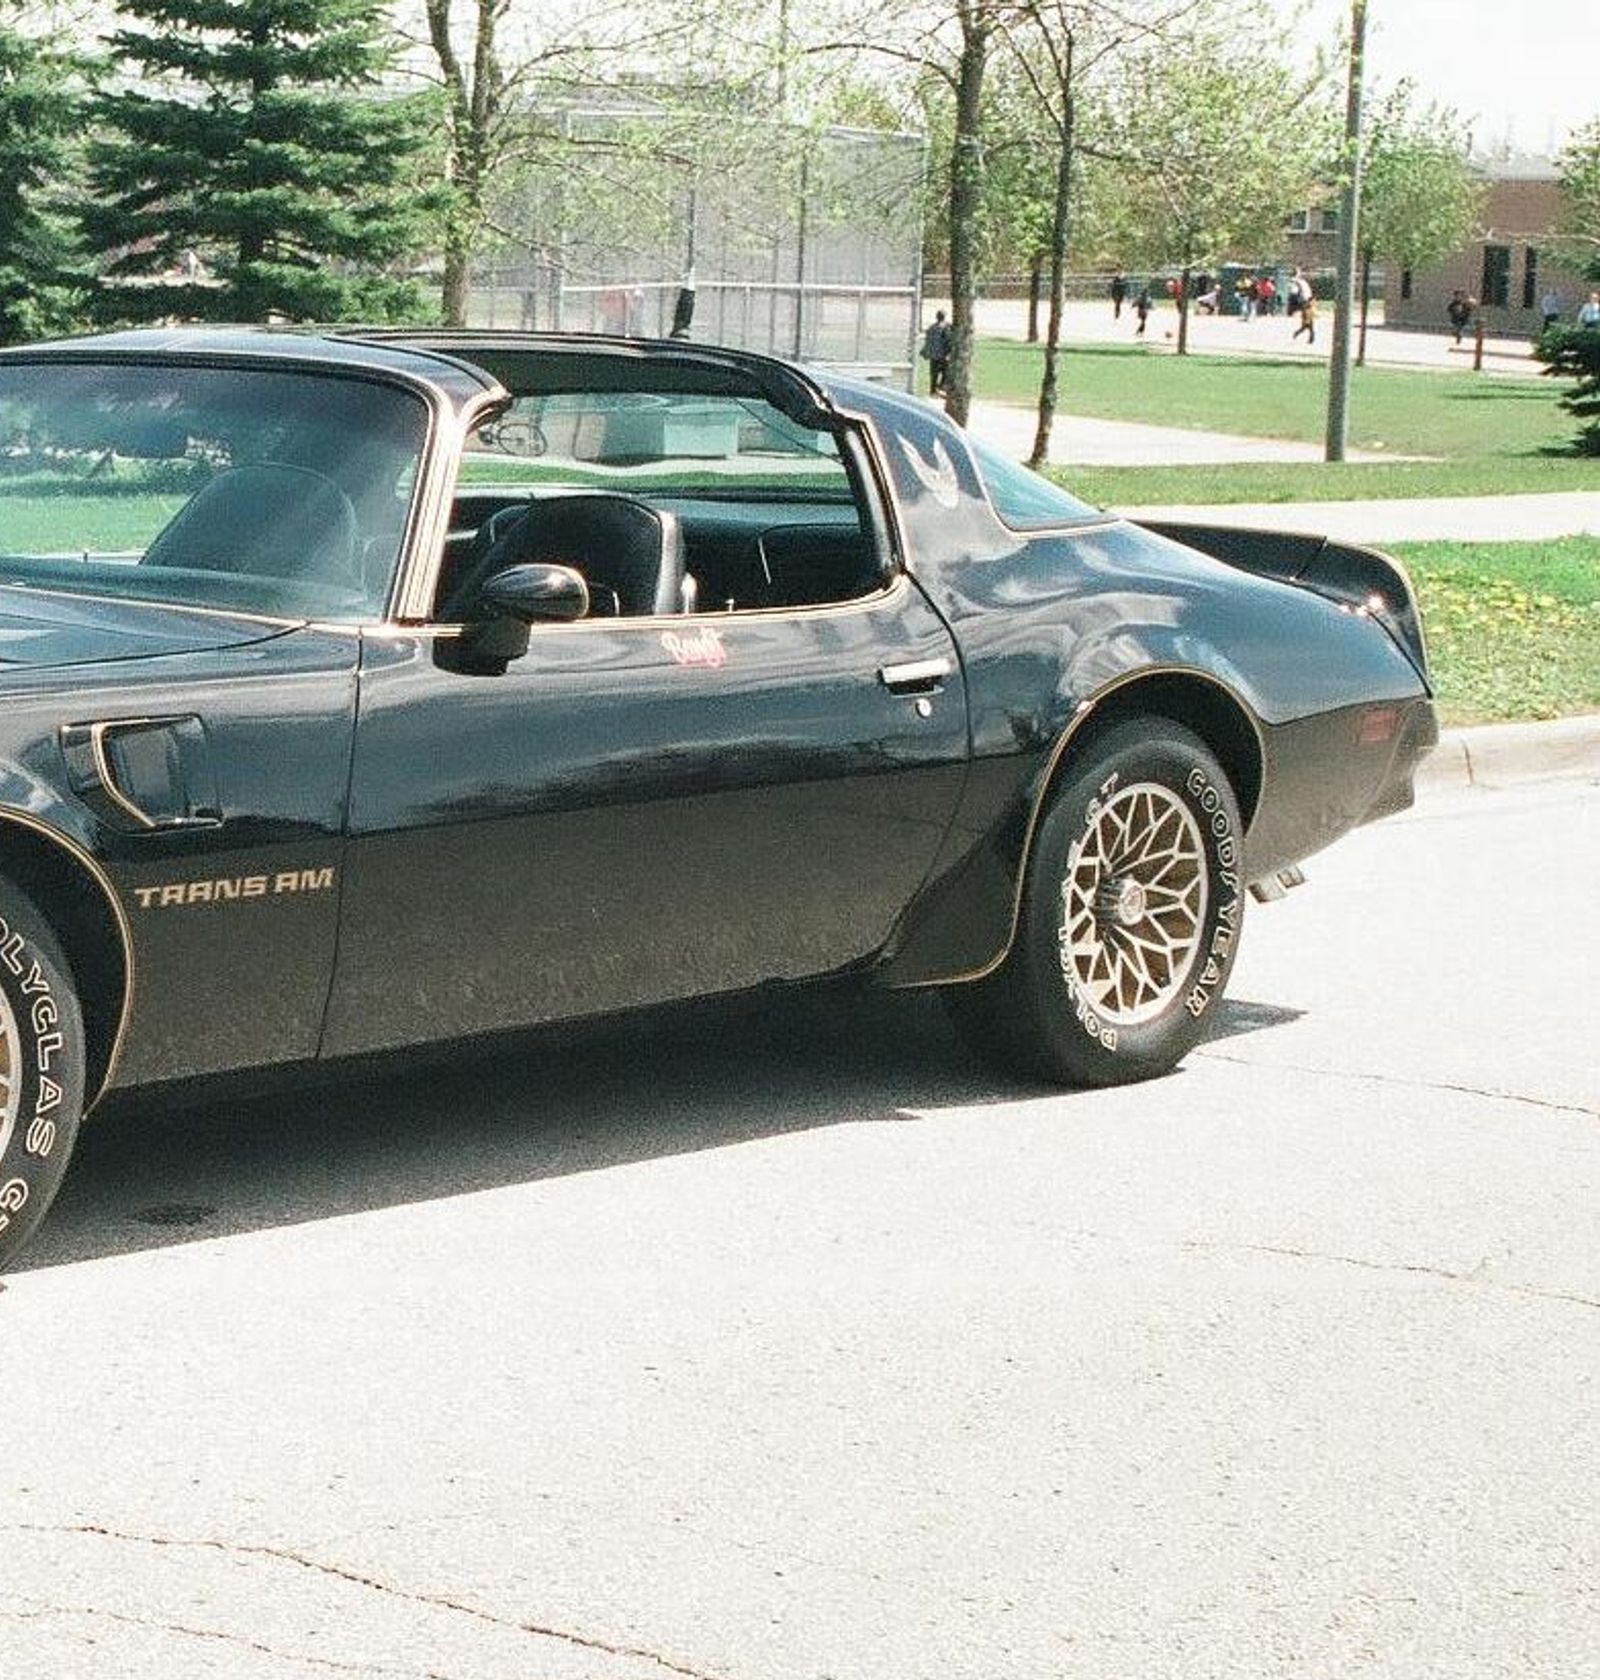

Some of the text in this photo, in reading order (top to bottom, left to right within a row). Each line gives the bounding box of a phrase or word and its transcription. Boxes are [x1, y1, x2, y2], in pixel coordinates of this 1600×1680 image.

[134, 866, 336, 908] TRANS AM
[1186, 768, 1240, 1017] GOODYEAR
